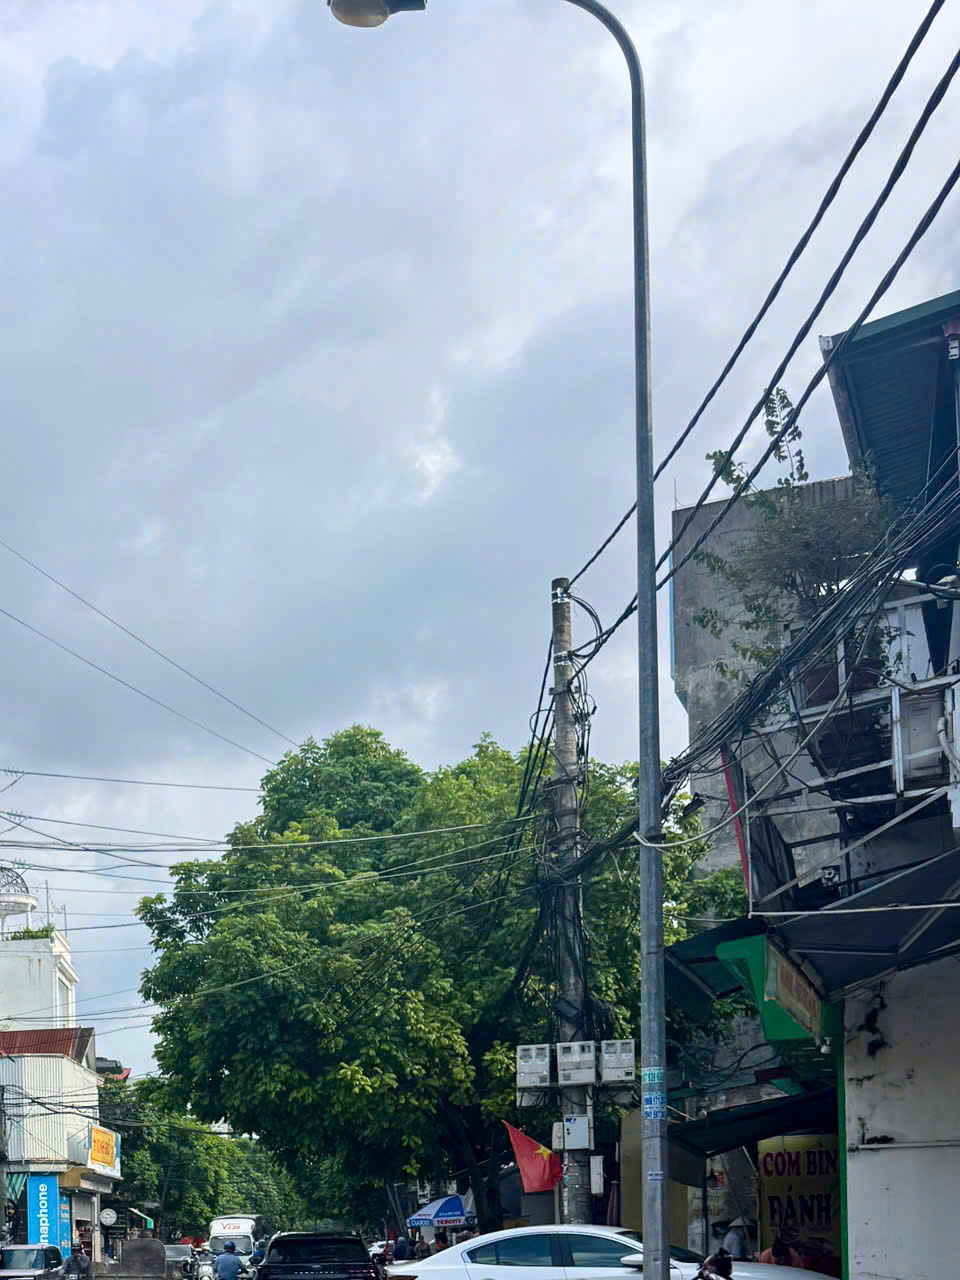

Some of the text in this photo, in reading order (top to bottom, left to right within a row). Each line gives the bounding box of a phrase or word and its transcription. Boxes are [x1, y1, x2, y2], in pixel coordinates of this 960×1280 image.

[763, 1143, 838, 1177] CƠM BÌN
[36, 1183, 50, 1246] inaphone
